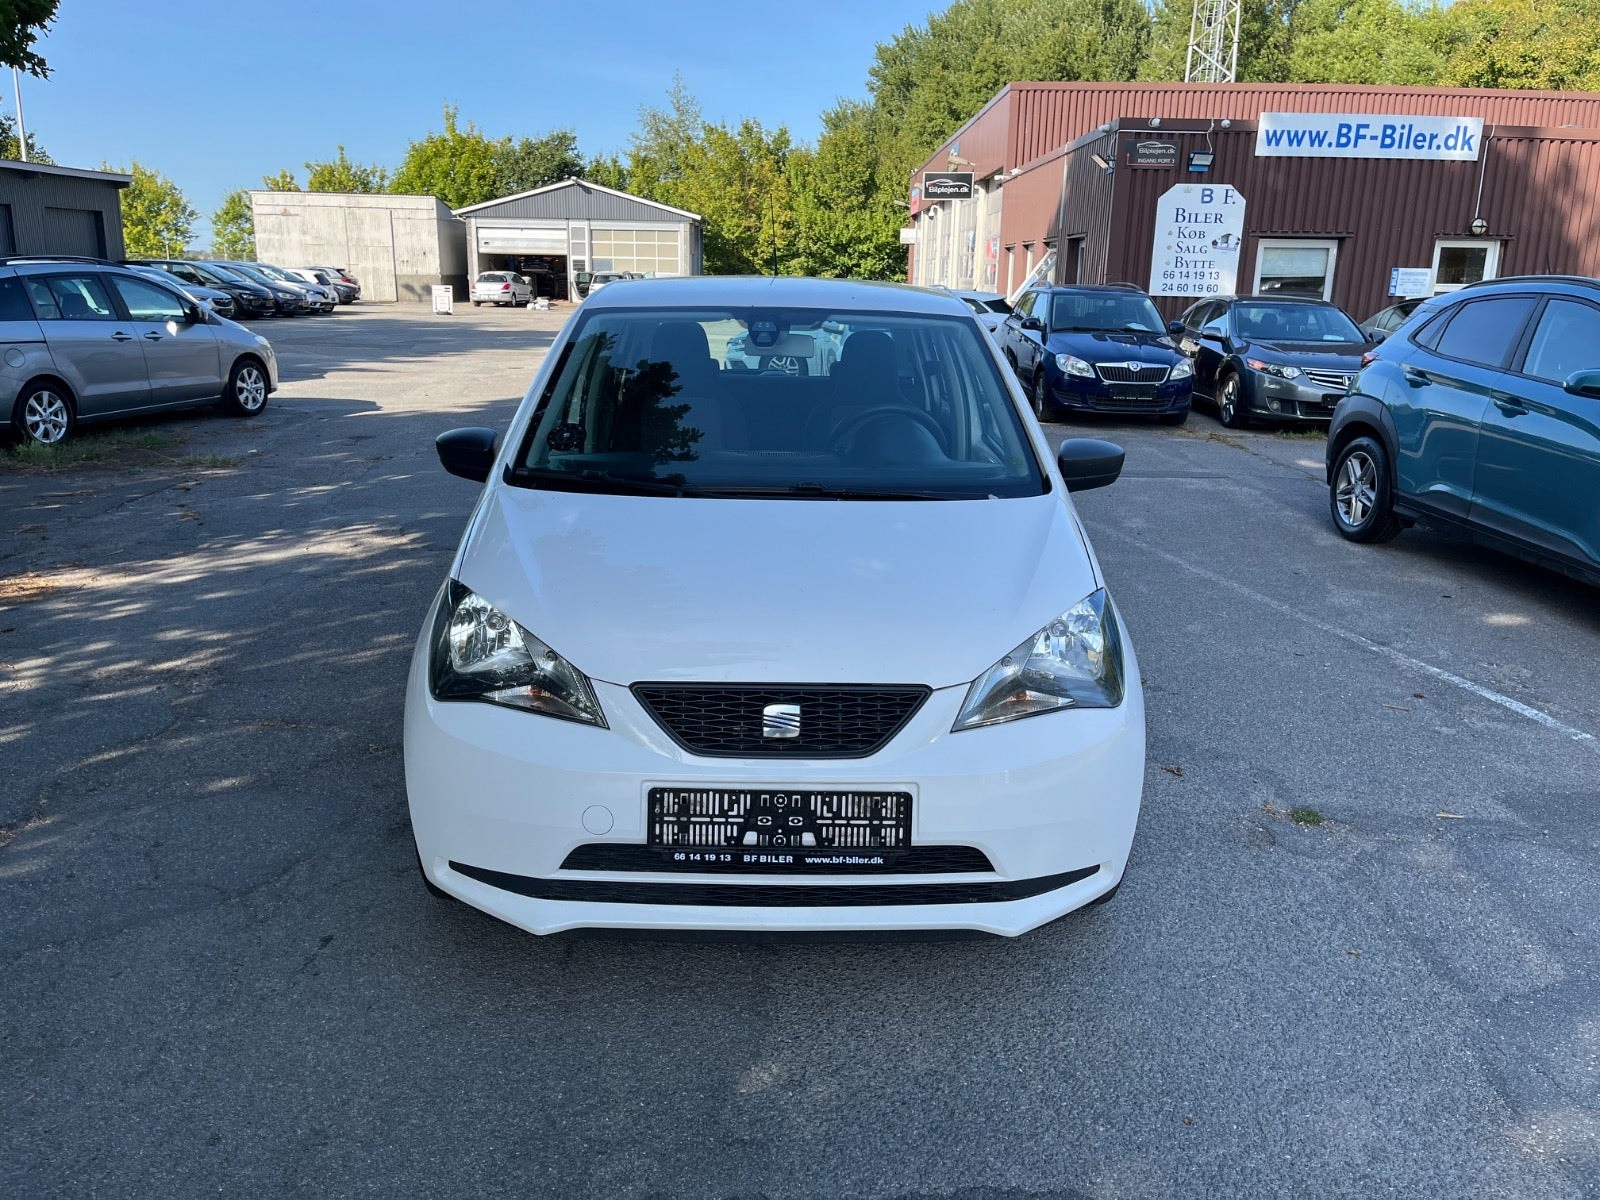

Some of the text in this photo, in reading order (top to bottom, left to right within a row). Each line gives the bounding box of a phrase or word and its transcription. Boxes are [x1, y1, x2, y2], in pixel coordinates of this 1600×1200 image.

[1264, 122, 1474, 152] www.BF-Biler.dk
[928, 186, 970, 194] Bilplejen.dk
[1200, 188, 1214, 204] B
[1174, 207, 1224, 224] BILER
[1177, 226, 1206, 239] KØB
[1175, 241, 1208, 254] SALG
[1174, 256, 1216, 269] BYTTE
[1163, 270, 1220, 280] 66 14 19 13
[1162, 283, 1218, 293] 24 60 19 60
[674, 852, 884, 865] 66 14 19 13 BF BILER www.bf-biler.dk
